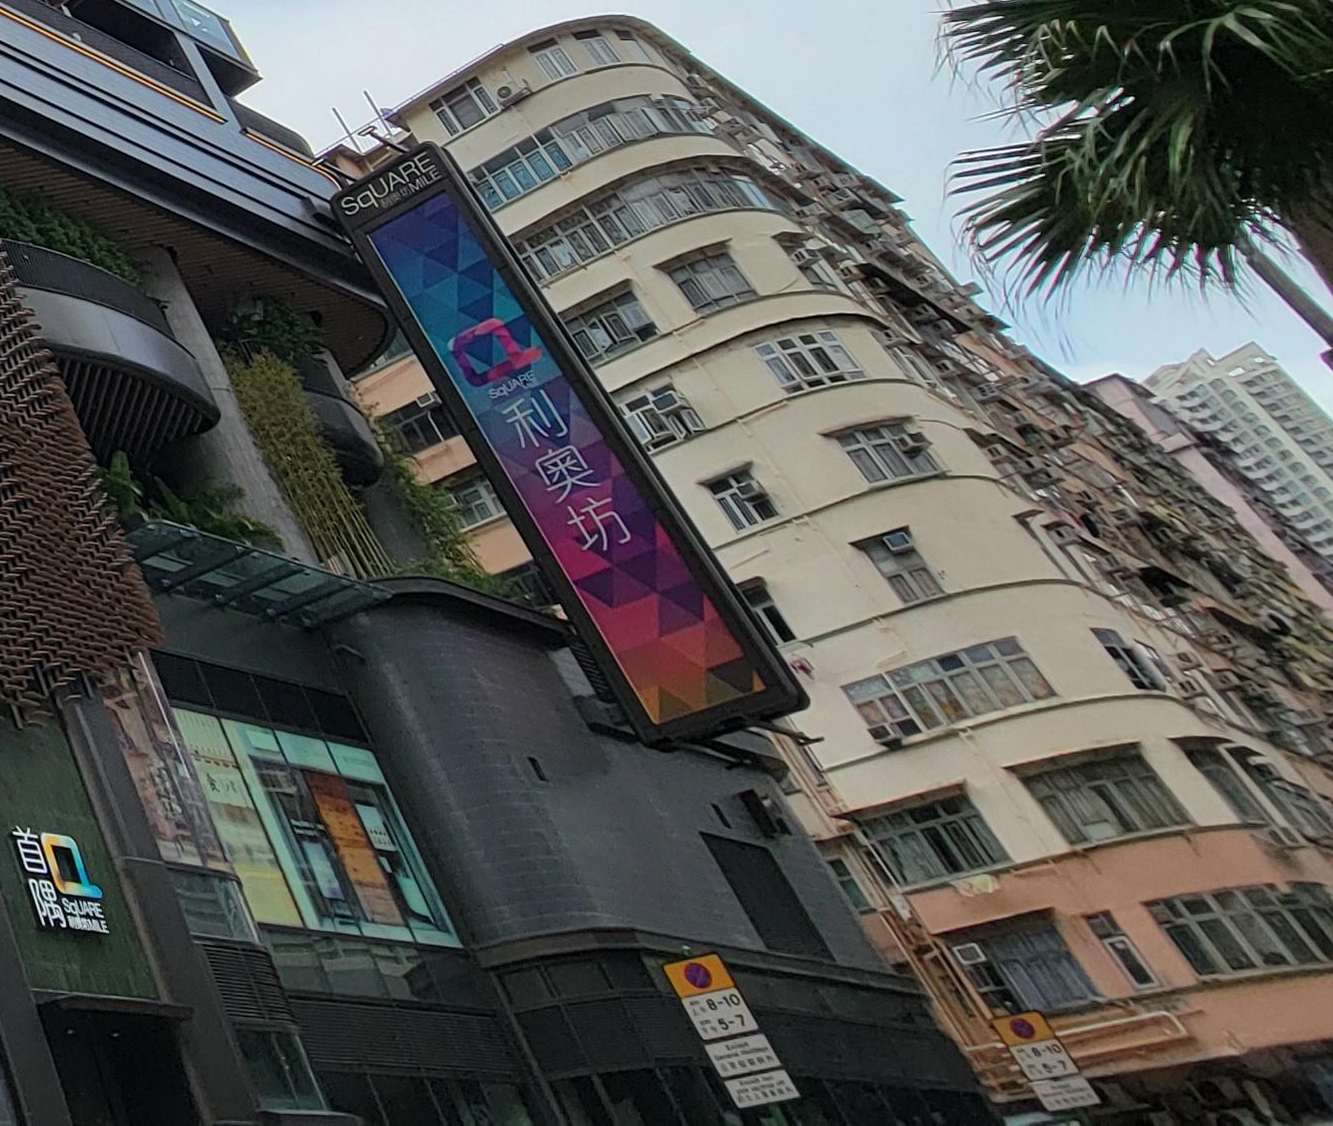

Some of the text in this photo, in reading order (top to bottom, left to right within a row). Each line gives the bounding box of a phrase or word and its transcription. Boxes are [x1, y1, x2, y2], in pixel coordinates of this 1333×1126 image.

[407, 167, 442, 194] MILE
[502, 389, 631, 551] 利奧坊
[12, 825, 67, 928] 首隅
[706, 994, 740, 1011] 8-10
[718, 1014, 745, 1031] 5-7
[1032, 1044, 1062, 1058] 8-10
